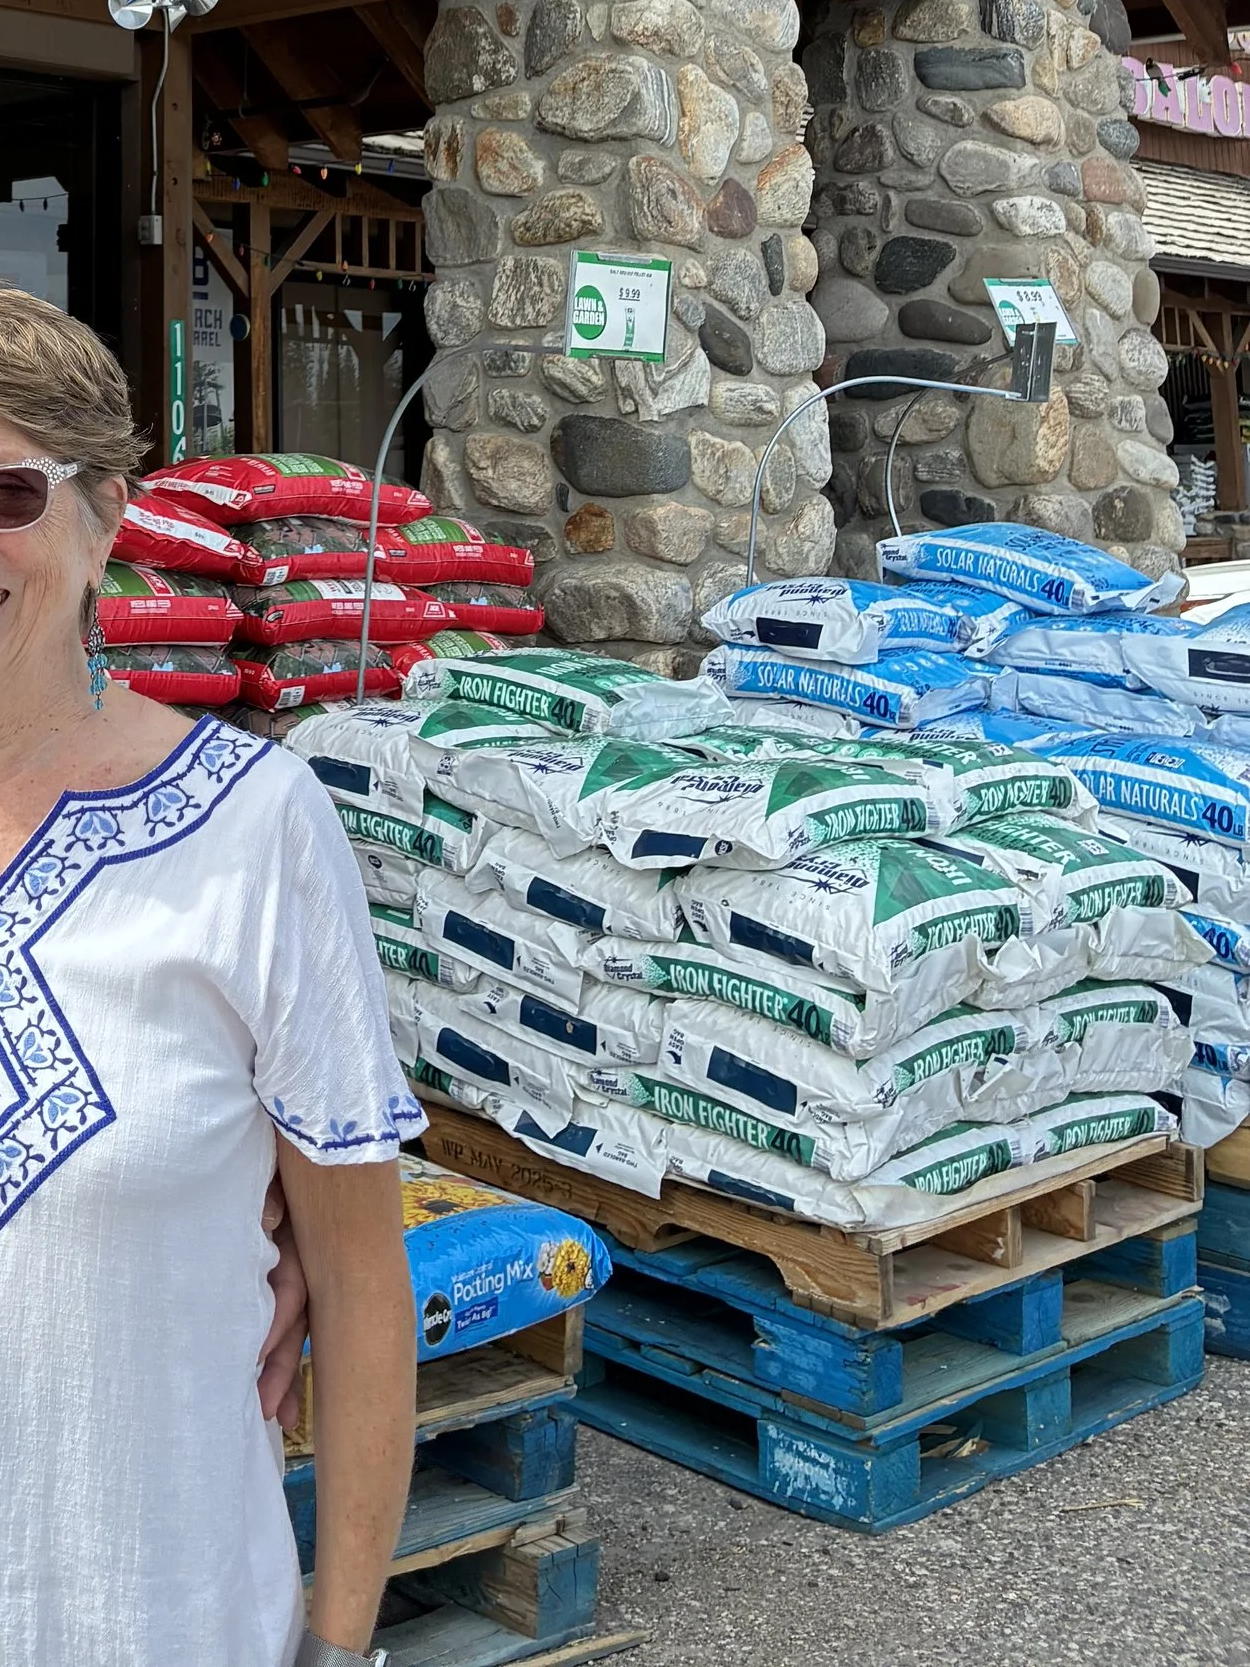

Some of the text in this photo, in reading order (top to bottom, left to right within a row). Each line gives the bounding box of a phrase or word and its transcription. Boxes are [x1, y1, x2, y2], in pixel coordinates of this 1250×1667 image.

[574, 296, 604, 312] LAWN &
[625, 288, 641, 299] 9.99
[573, 310, 605, 326] GARDEN
[937, 548, 1064, 603] SOLAR NATURALS 40
[459, 675, 492, 699] IRON
[493, 682, 550, 718] FIGHTER
[551, 697, 575, 730] 40
[863, 690, 889, 718] 40
[1078, 773, 1115, 802] OLAR
[1121, 779, 1199, 822] NATURALS
[1202, 801, 1233, 833] 40
[359, 813, 412, 852] FIGHTER
[412, 829, 436, 862] 40
[603, 963, 633, 974] Diamond
[616, 972, 643, 981] Crystal
[669, 963, 822, 1040] IRON FIGHTER 40
[653, 1085, 696, 1121] IRON
[699, 1101, 770, 1148] FIGHTER
[770, 1128, 802, 1162] 40
[453, 1260, 533, 1306] Potting Mix
